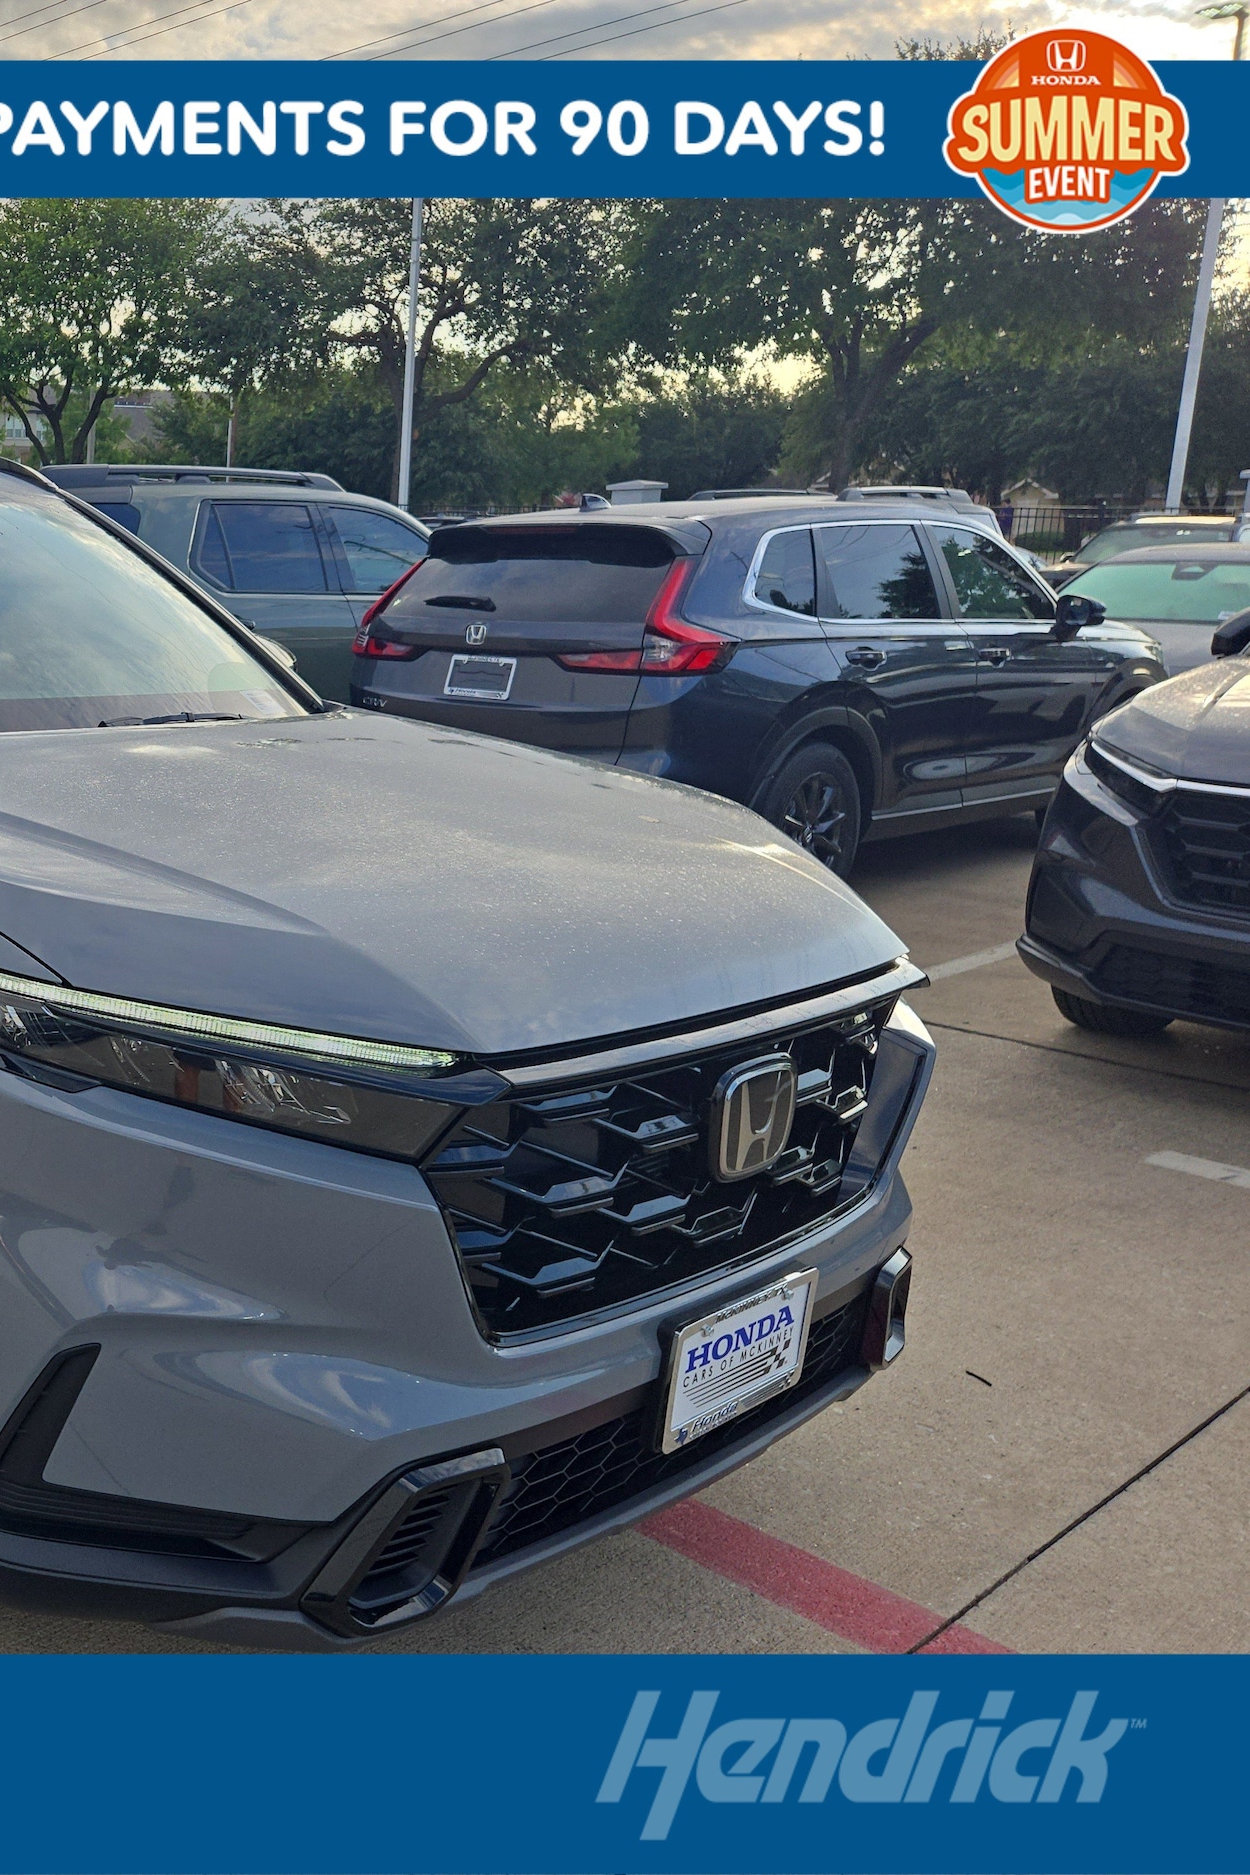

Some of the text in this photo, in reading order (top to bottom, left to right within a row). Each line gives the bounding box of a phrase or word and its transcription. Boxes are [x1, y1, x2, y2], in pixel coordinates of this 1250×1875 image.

[683, 1326, 794, 1388] CARS OF MCKINNEY
[685, 1304, 795, 1374] HONDA
